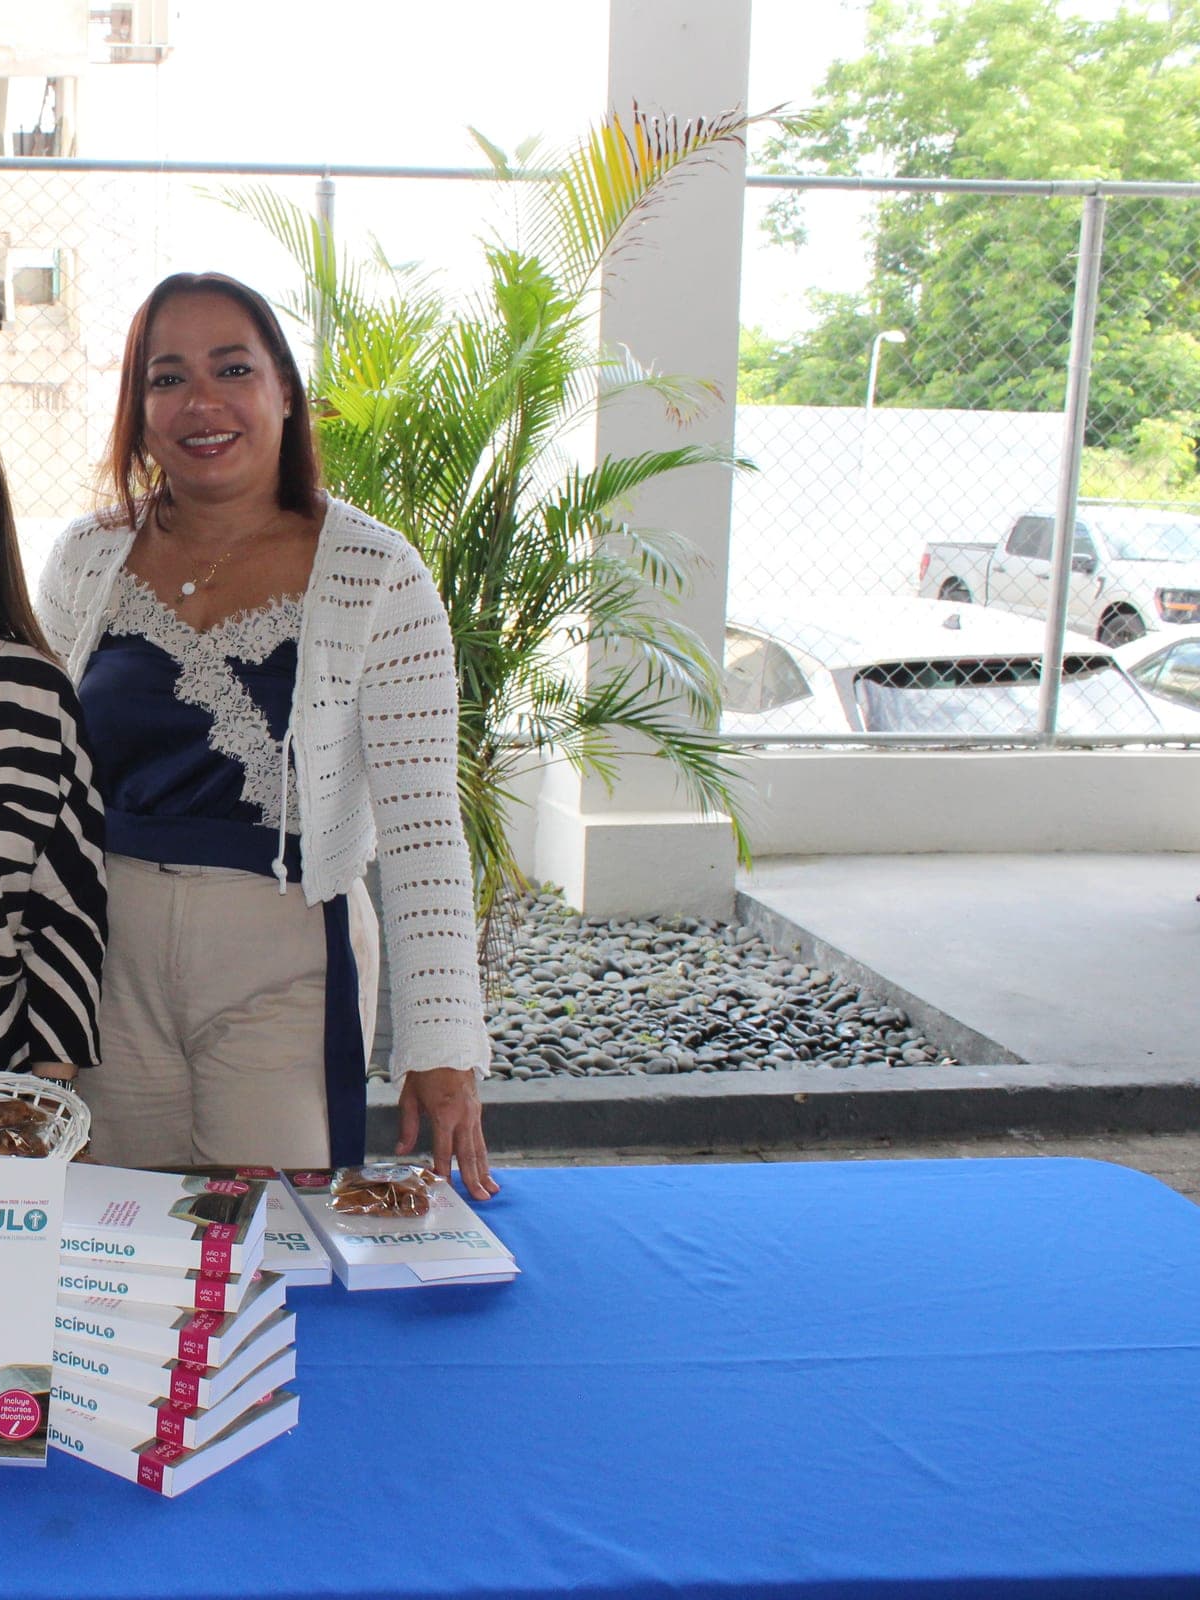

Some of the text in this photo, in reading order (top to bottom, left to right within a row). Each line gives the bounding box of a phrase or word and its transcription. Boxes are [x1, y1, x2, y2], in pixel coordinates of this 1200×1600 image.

[277, 1241, 310, 1250] EL
[456, 1240, 492, 1249] EL
[57, 1275, 129, 1295] ISCÍPULO
[55, 1316, 115, 1339] SCÍPULO
[183, 1340, 196, 1348] AÑO
[52, 1350, 109, 1376] SCÍPULO
[3, 1397, 30, 1407] Incluye
[50, 1385, 98, 1411] CÍPULO
[49, 1424, 84, 1452] ÍPULO
